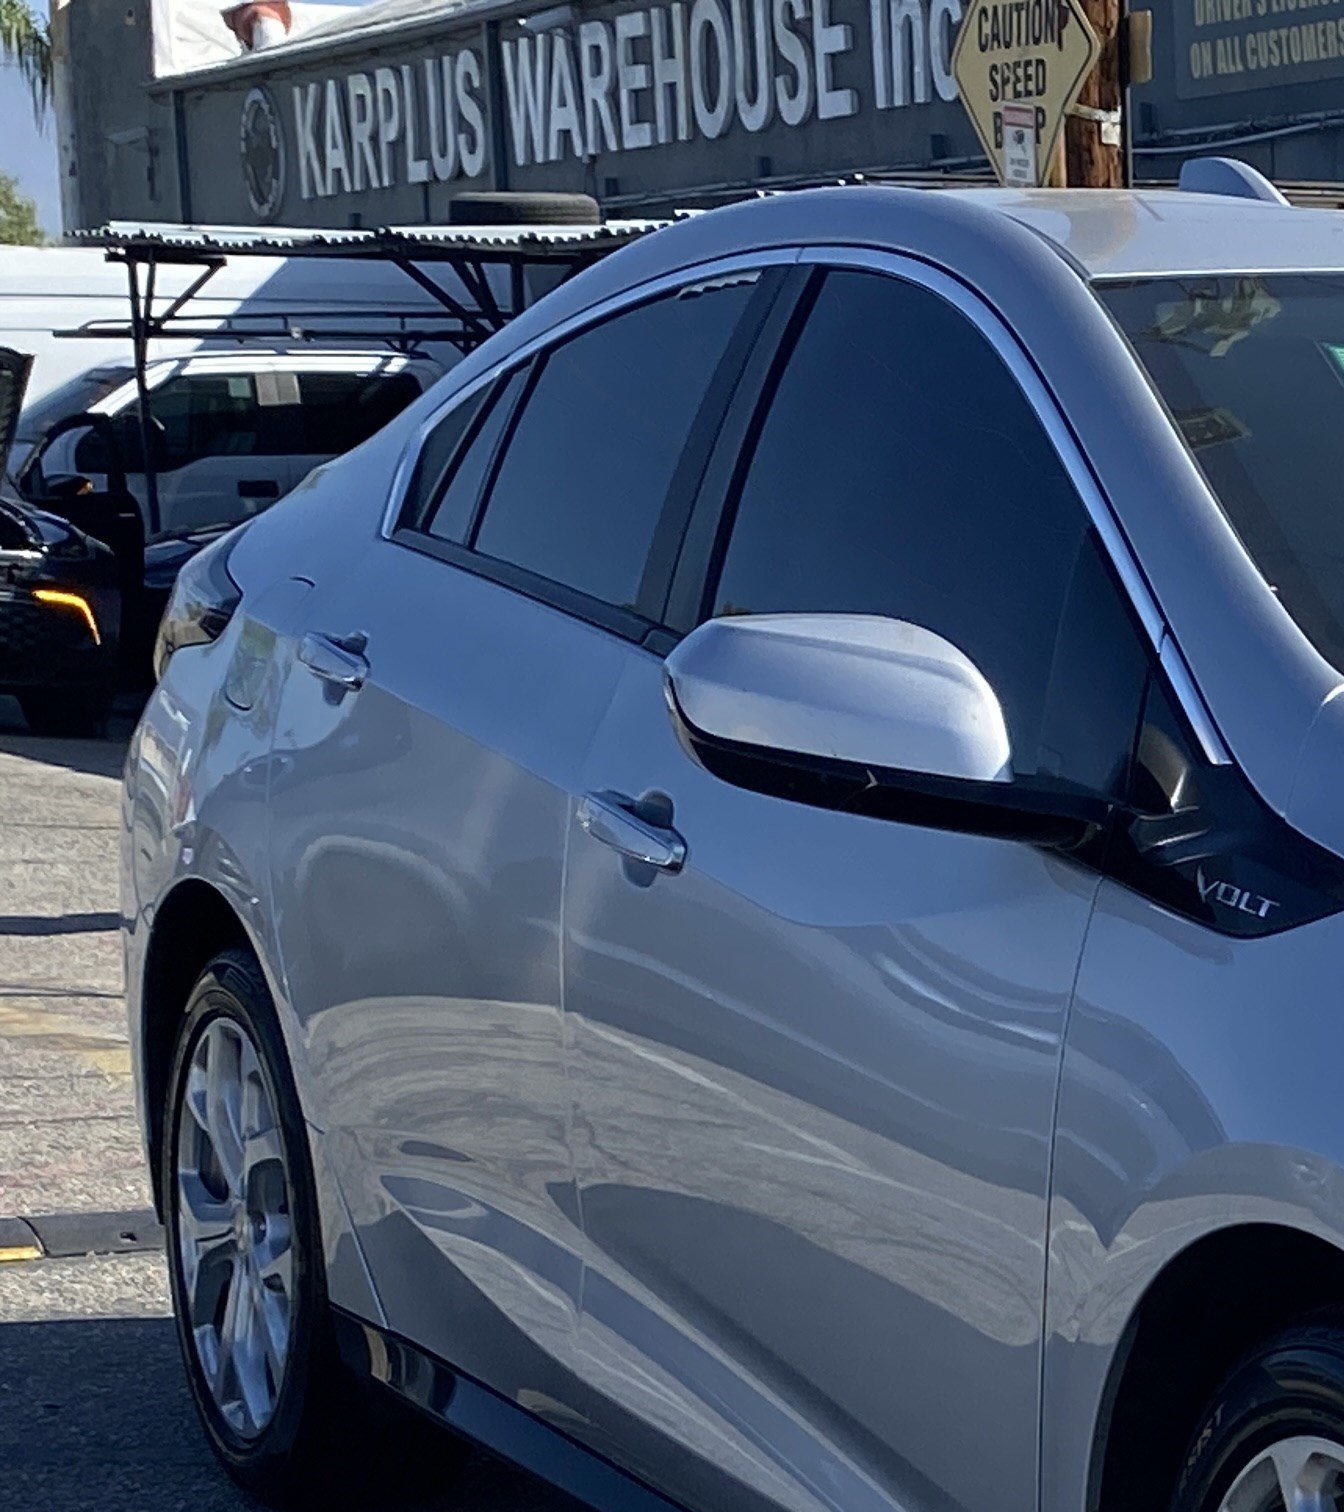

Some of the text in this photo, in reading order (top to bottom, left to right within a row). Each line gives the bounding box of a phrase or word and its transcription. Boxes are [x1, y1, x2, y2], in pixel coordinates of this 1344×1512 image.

[977, 0, 1056, 53] CAUTION
[988, 58, 1047, 102] SPEED
[1190, 41, 1214, 79] ON
[1216, 36, 1244, 74] ALL
[292, 49, 485, 200] KARPLUS
[501, 0, 860, 167] WAREHOUSE
[992, 106, 1047, 149] BP
[1196, 865, 1281, 918] VOLT
